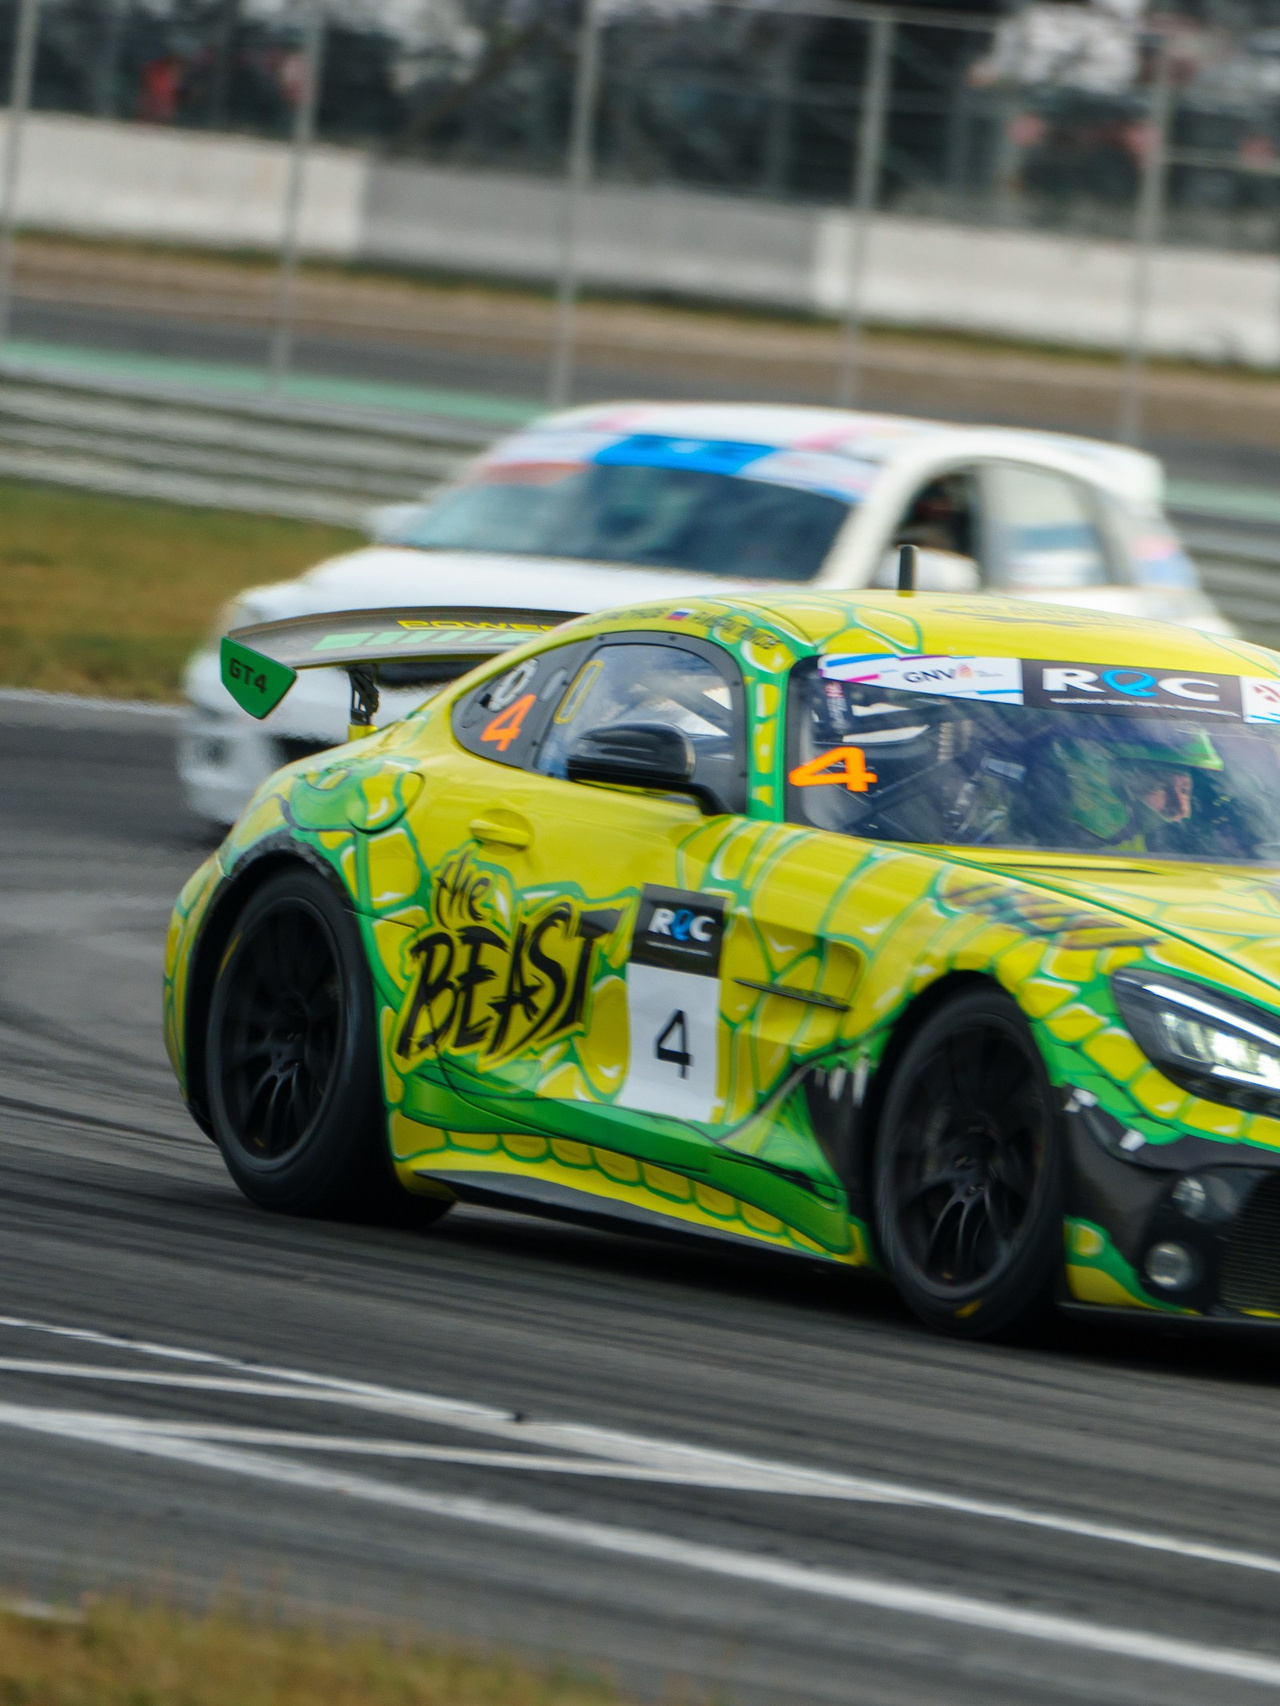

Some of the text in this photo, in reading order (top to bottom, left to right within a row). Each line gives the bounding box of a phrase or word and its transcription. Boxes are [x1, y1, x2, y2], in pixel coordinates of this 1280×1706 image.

[228, 657, 268, 694] GT4
[903, 667, 957, 684] GNV
[480, 693, 537, 752] 4
[788, 746, 878, 793] 4
[395, 902, 624, 1064] BEAST
[655, 1008, 694, 1081] 4
